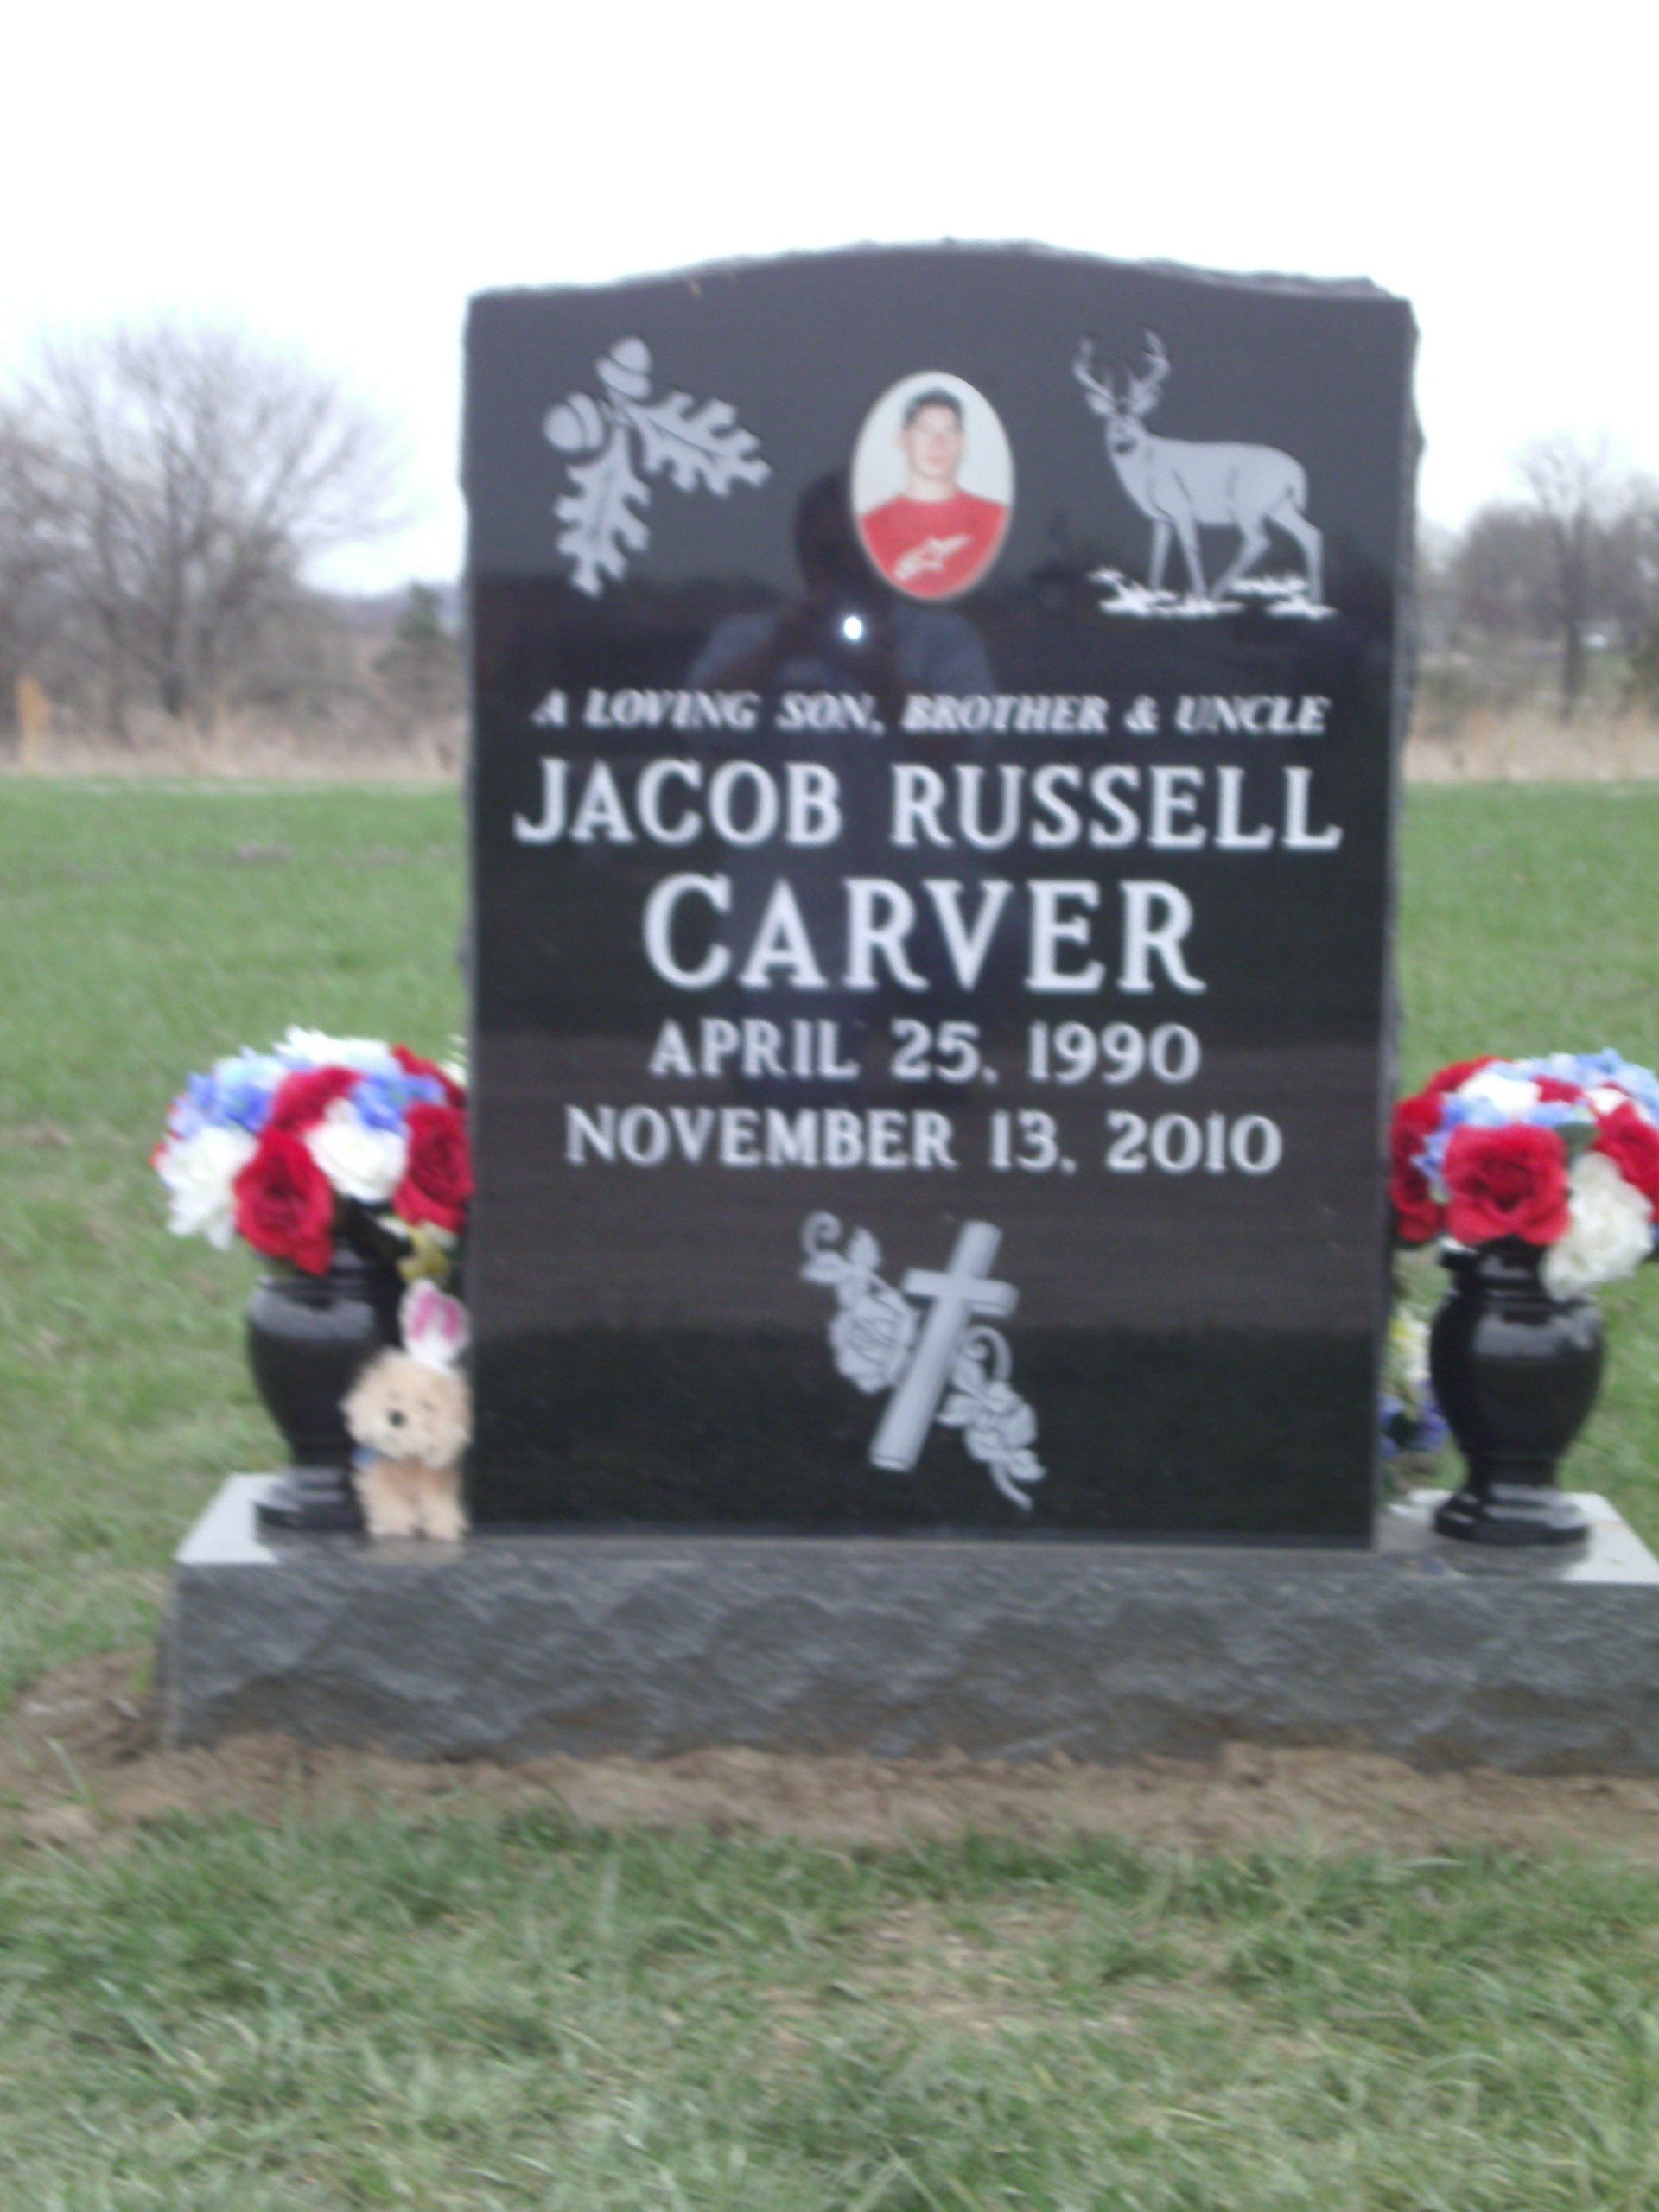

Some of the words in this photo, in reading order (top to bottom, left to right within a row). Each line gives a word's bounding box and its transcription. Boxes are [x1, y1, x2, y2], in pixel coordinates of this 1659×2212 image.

[533, 690, 567, 727] A
[583, 689, 760, 731] LOVING
[775, 691, 885, 735] SON,
[899, 693, 1109, 734] BROTHER
[1123, 695, 1159, 734] &
[1174, 695, 1332, 734] UNCLE
[513, 757, 844, 849] JACOB
[889, 762, 1344, 851] RUSSELL
[643, 872, 1207, 994] CARVER
[648, 1018, 861, 1080] APRIL
[1027, 1021, 1202, 1086] 1990
[565, 1104, 959, 1171] NOVEMBER
[1105, 1109, 1283, 1175] 2010
